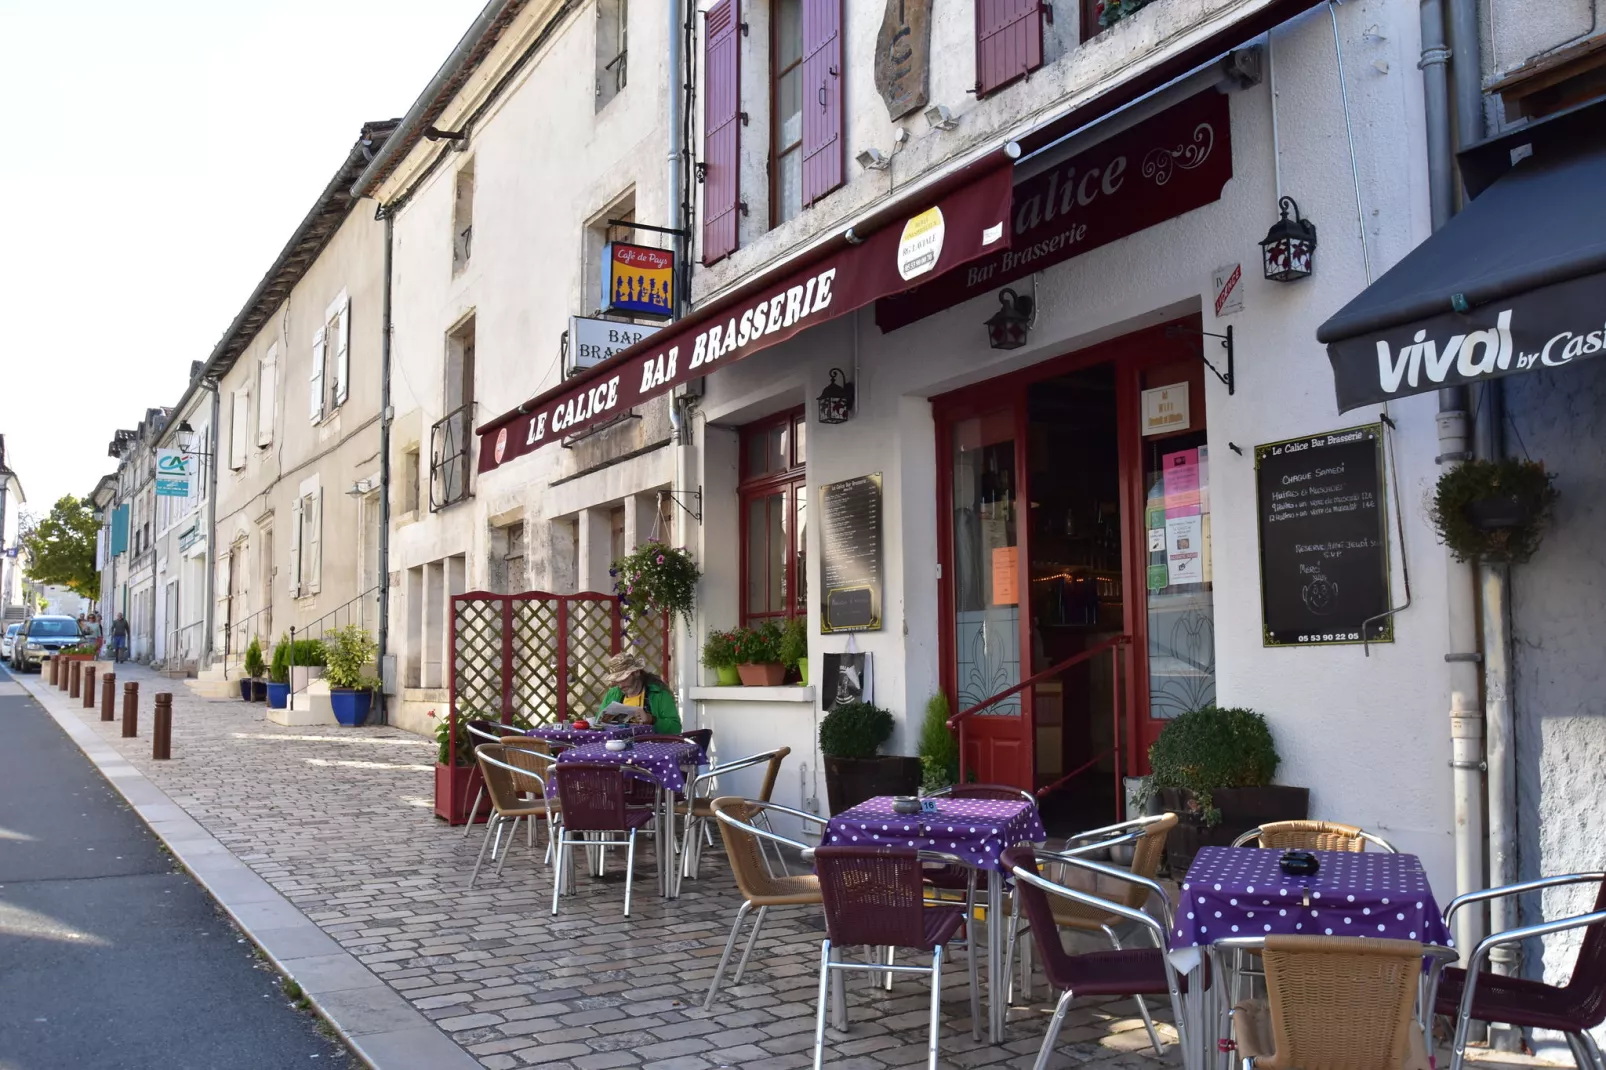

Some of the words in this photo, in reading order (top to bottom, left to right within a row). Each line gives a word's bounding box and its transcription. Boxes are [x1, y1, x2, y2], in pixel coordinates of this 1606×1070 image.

[1011, 156, 1127, 235] alice
[617, 249, 636, 264] Café
[637, 252, 647, 262] de
[649, 253, 668, 268] Pays
[966, 262, 997, 288] Bar
[1001, 223, 1087, 273] Brasserie
[609, 330, 642, 345] BAR
[526, 412, 548, 446] LE
[552, 375, 620, 433] CALICE
[639, 346, 679, 393] BAR
[689, 268, 836, 369] BRASSERIE
[1516, 351, 1540, 369] by
[1272, 446, 1282, 456] Le
[1284, 441, 1308, 454] Calice
[1311, 438, 1325, 448] Bar
[1327, 431, 1363, 445] Brasserie
[1348, 632, 1359, 640] 05
[923, 801, 934, 809] 16
